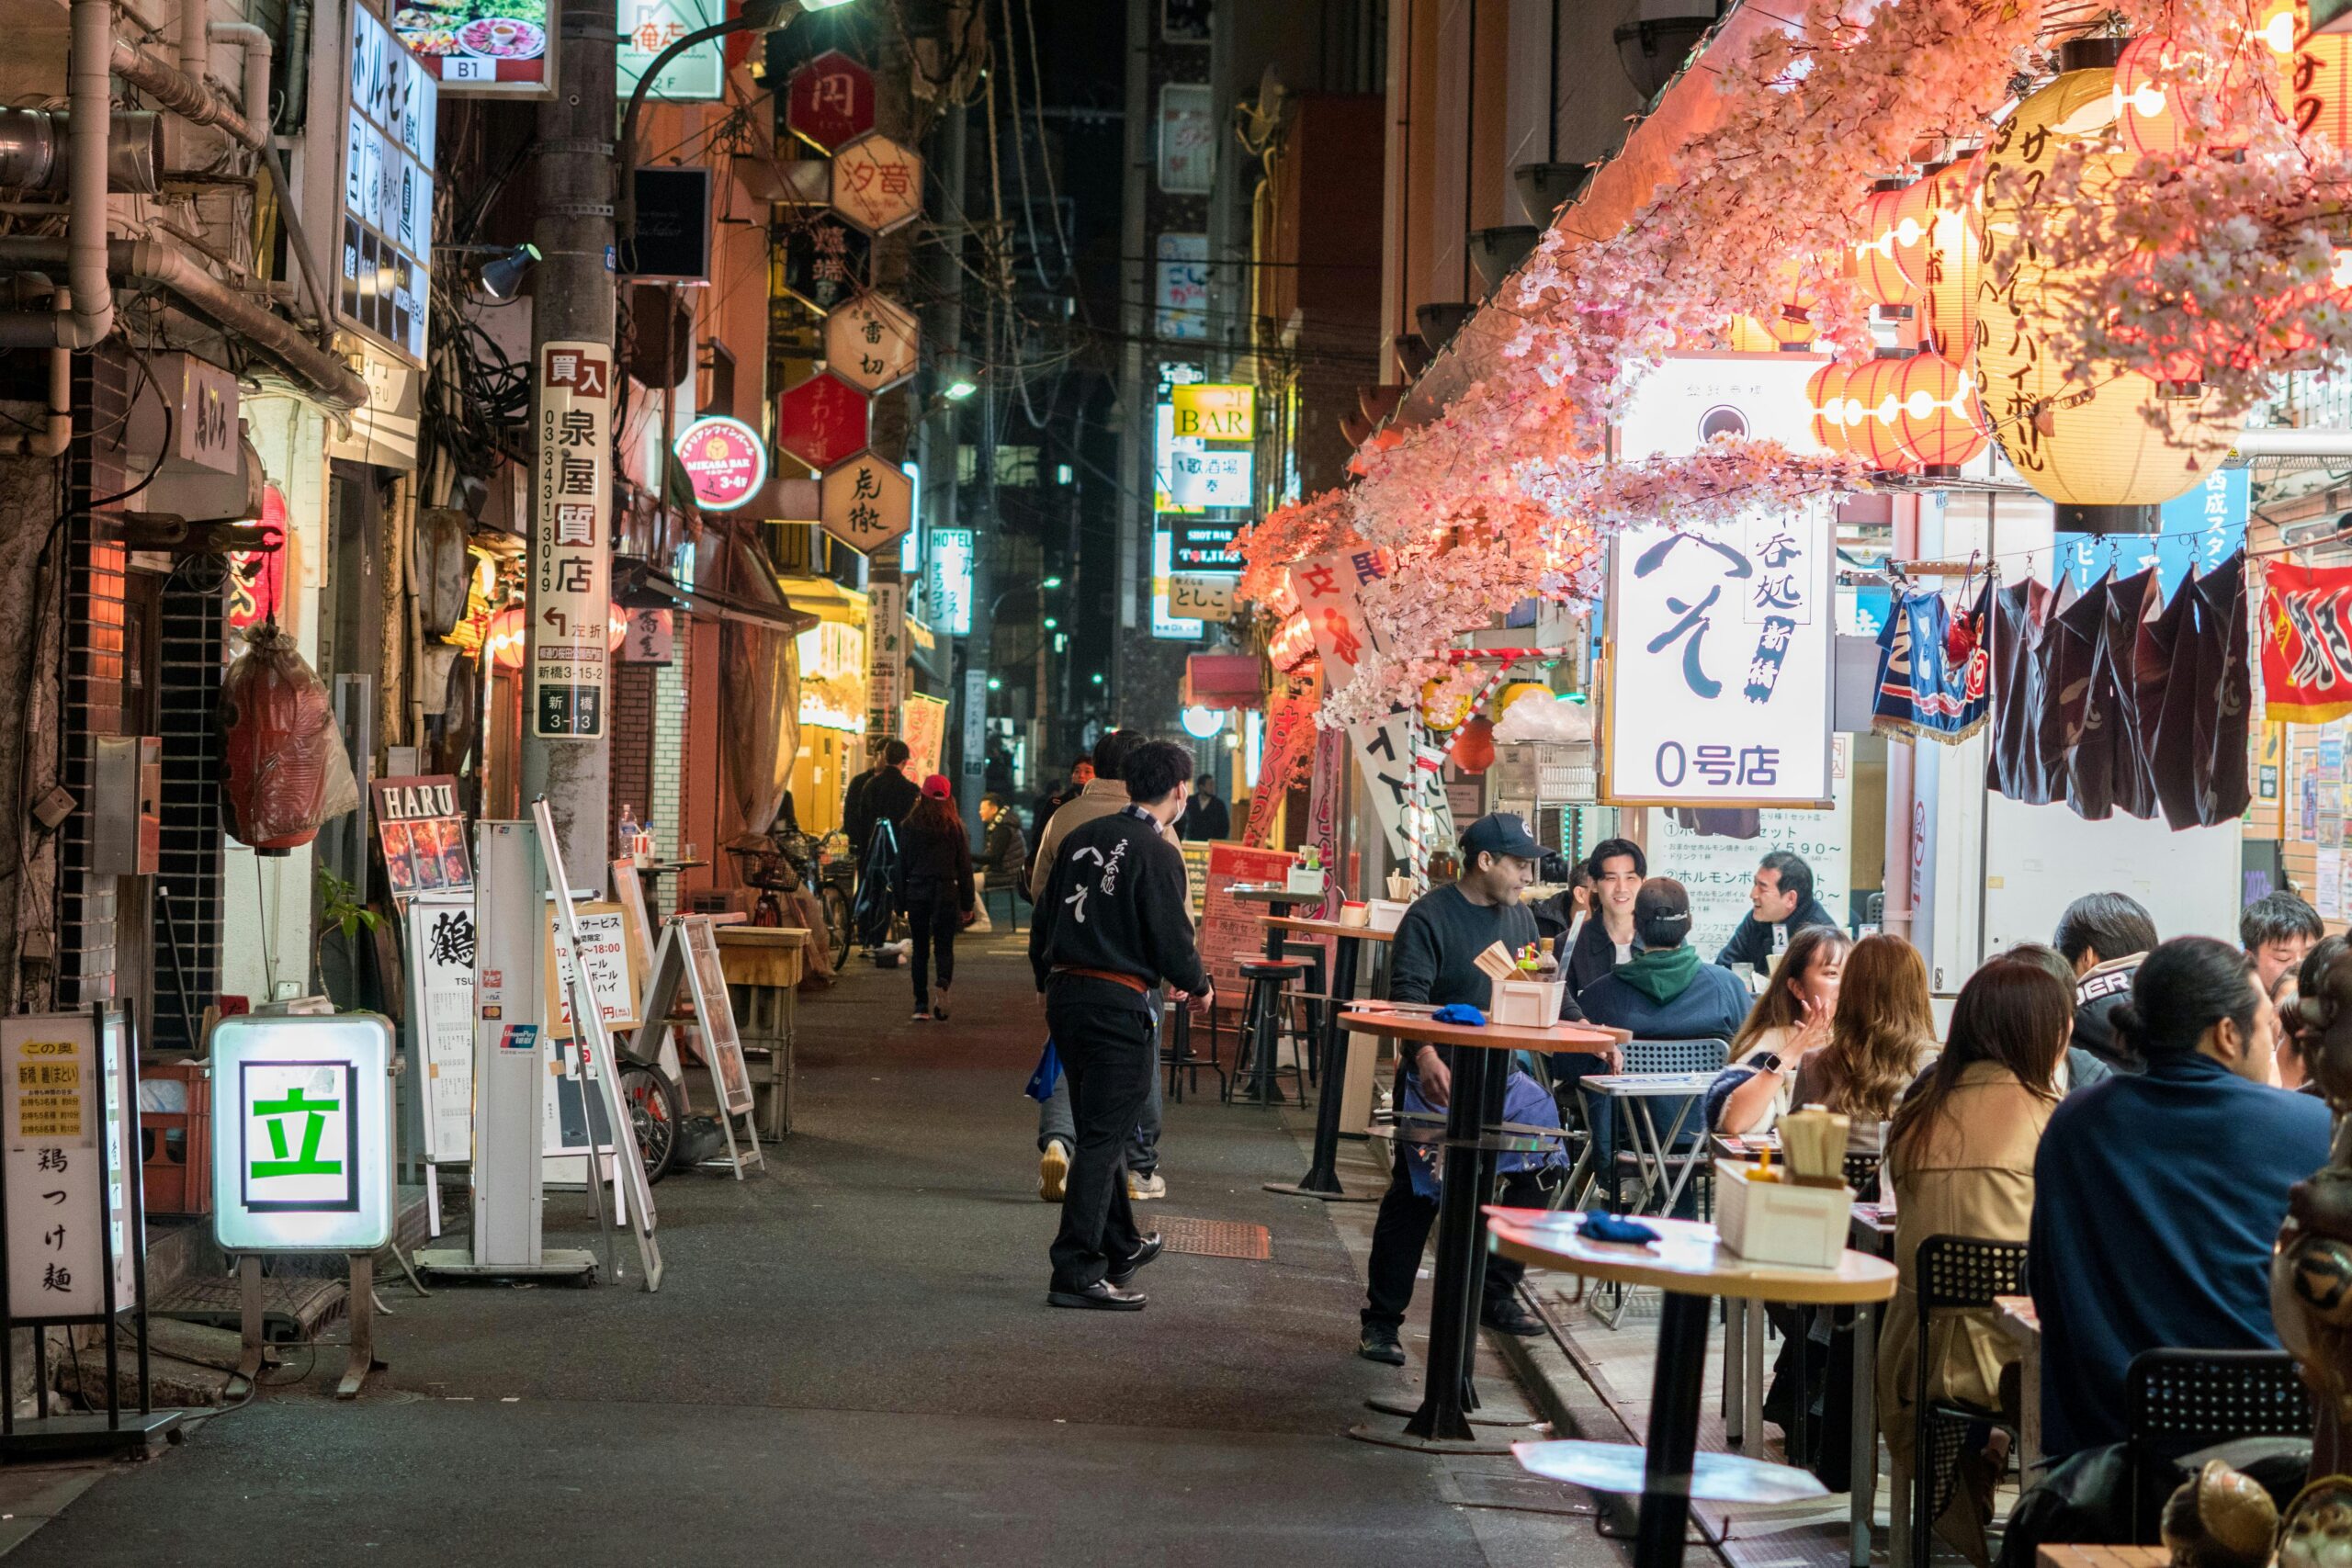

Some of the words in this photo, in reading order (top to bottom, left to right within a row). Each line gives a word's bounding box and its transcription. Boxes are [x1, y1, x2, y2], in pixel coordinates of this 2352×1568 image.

[458, 62, 478, 77] B1
[843, 162, 908, 193] 汐音
[861, 321, 885, 375] 雷切
[552, 355, 603, 393] 買入
[1181, 410, 1243, 433] BAR
[687, 461, 728, 470] MIKASA
[729, 459, 751, 468] BAR
[555, 409, 596, 593] 泉屋質店
[847, 468, 889, 534] 虎徹
[933, 533, 971, 547] HOTEL
[1188, 530, 1211, 540] SHOT
[1213, 530, 1232, 540] BAR
[932, 561, 944, 620] チェックイン
[1176, 588, 1225, 606] としこ
[1300, 563, 1340, 599] 女
[1634, 531, 1754, 700] へそ
[537, 667, 603, 679] 新橋3-15-2
[548, 696, 594, 710] 新橋
[550, 716, 591, 728] 3-13
[1655, 740, 1780, 787] 0号店
[382, 784, 454, 818] HARU
[1065, 846, 1104, 924] へそ
[429, 910, 474, 969] 鶴
[1778, 932, 1783, 946] 2
[28, 1043, 73, 1055] この奥
[20, 1066, 37, 1084] 新橋
[251, 1088, 342, 1179] 立
[38, 1147, 72, 1292] 鶏つけ麺
